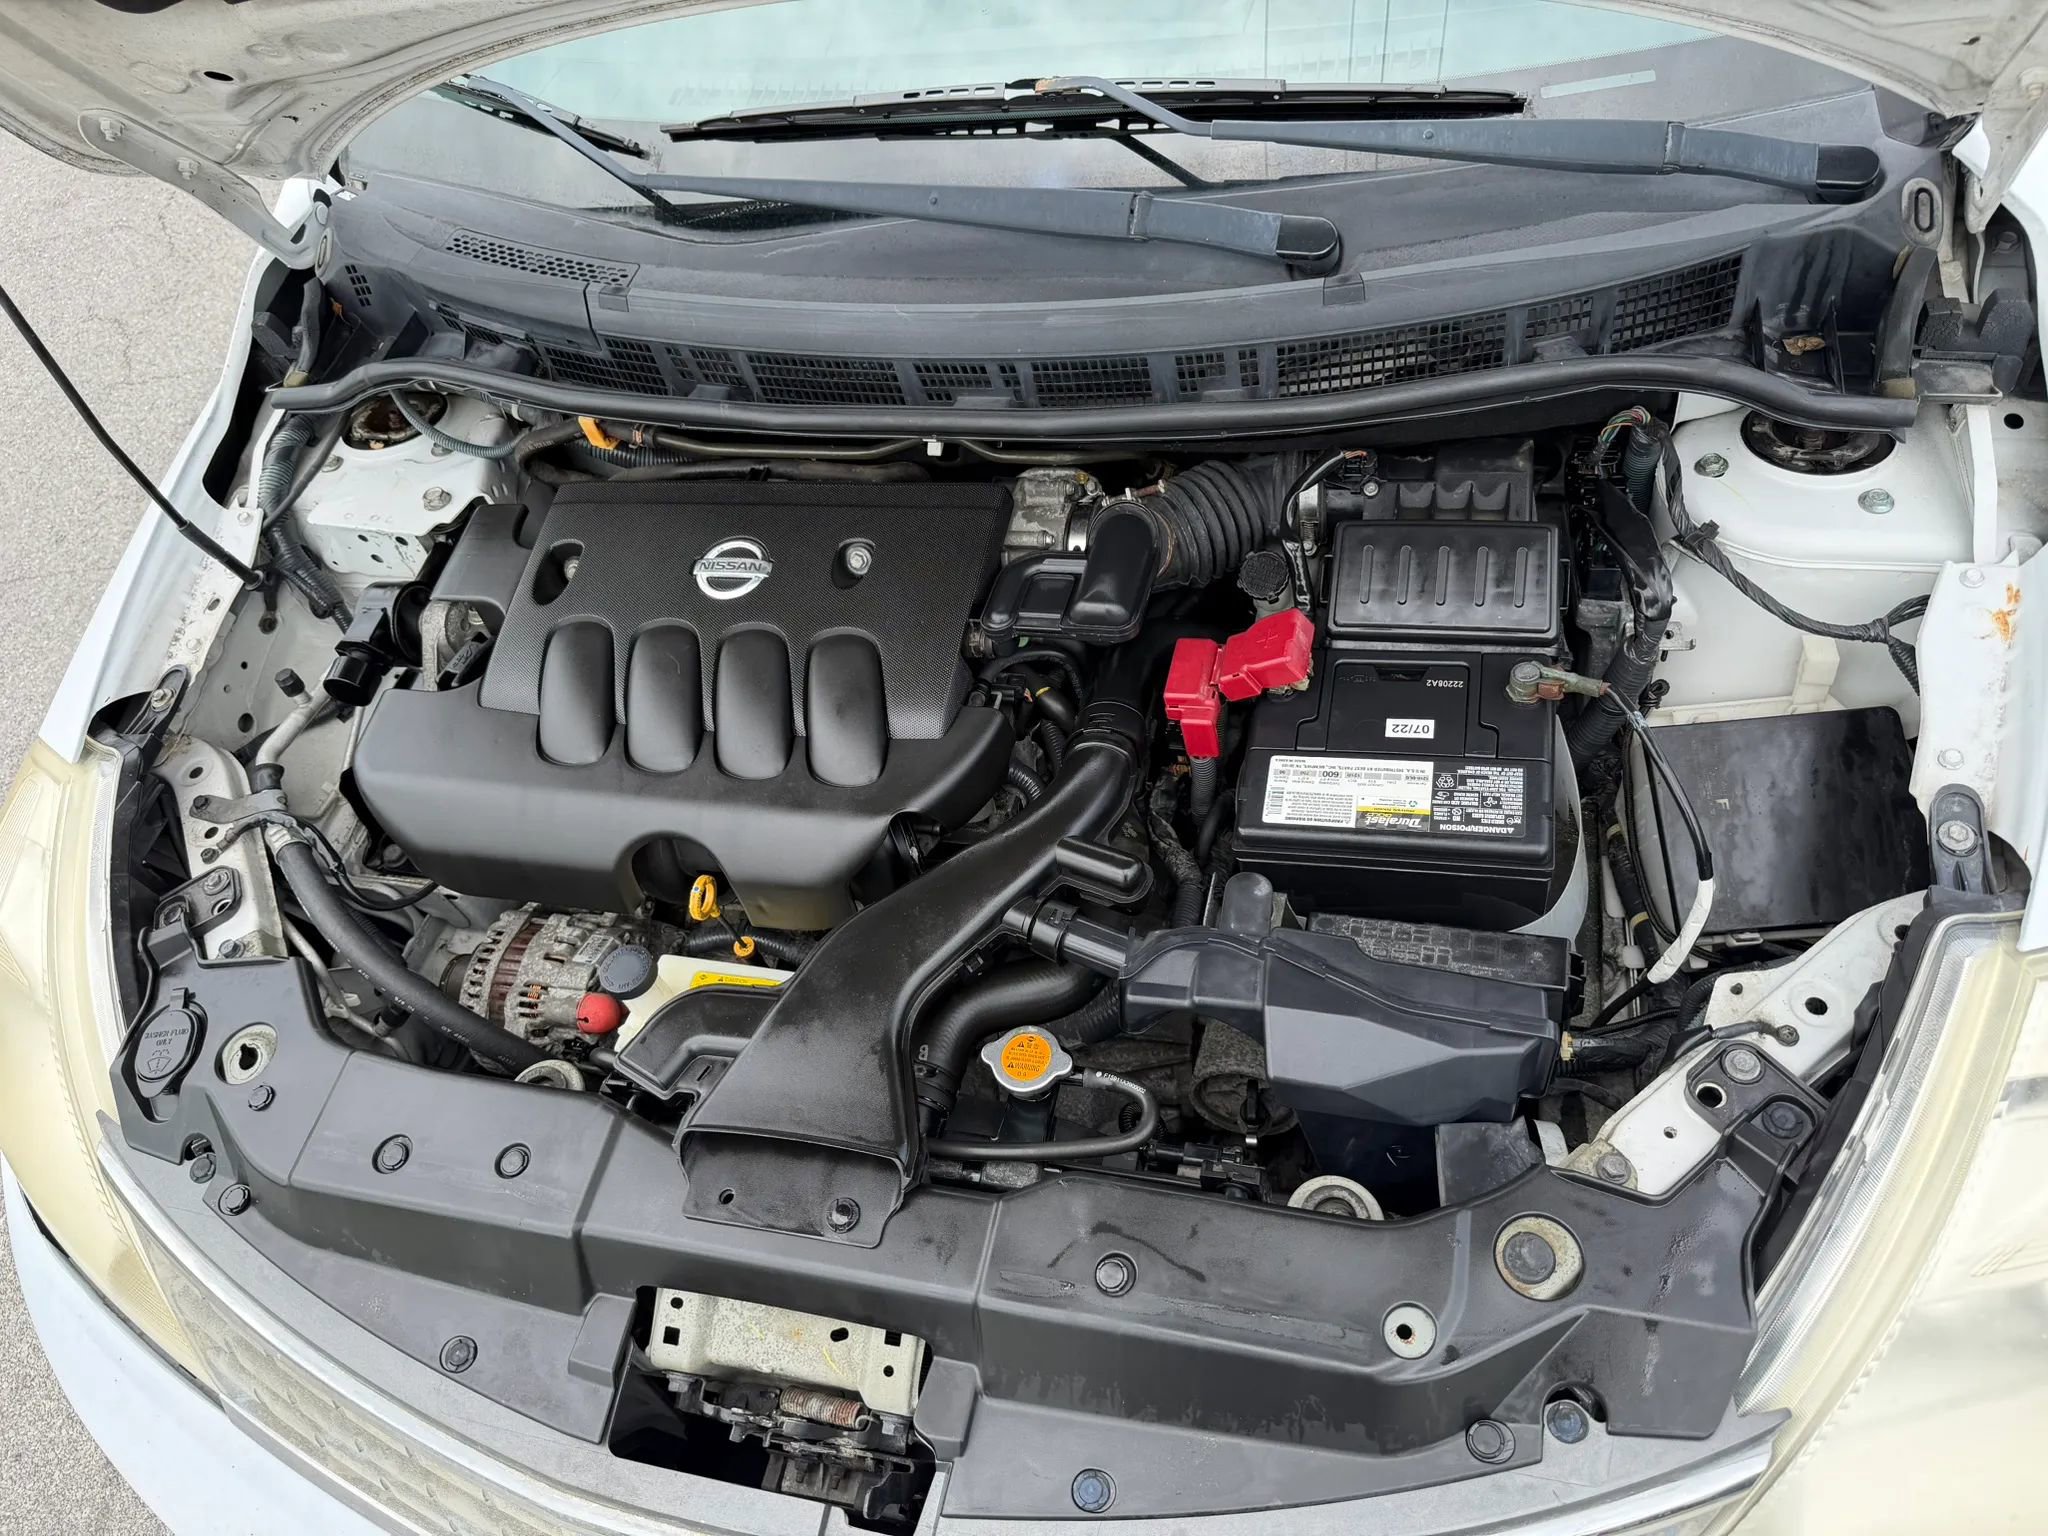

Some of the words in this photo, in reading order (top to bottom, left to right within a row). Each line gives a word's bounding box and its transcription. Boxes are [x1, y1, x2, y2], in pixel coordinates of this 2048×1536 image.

[699, 561, 762, 571] NISSAN
[1426, 679, 1464, 688] 22208A2
[1391, 724, 1430, 734] 07/22
[1364, 816, 1422, 827] Duralast
[1440, 824, 1507, 833] DANGER/POISON
